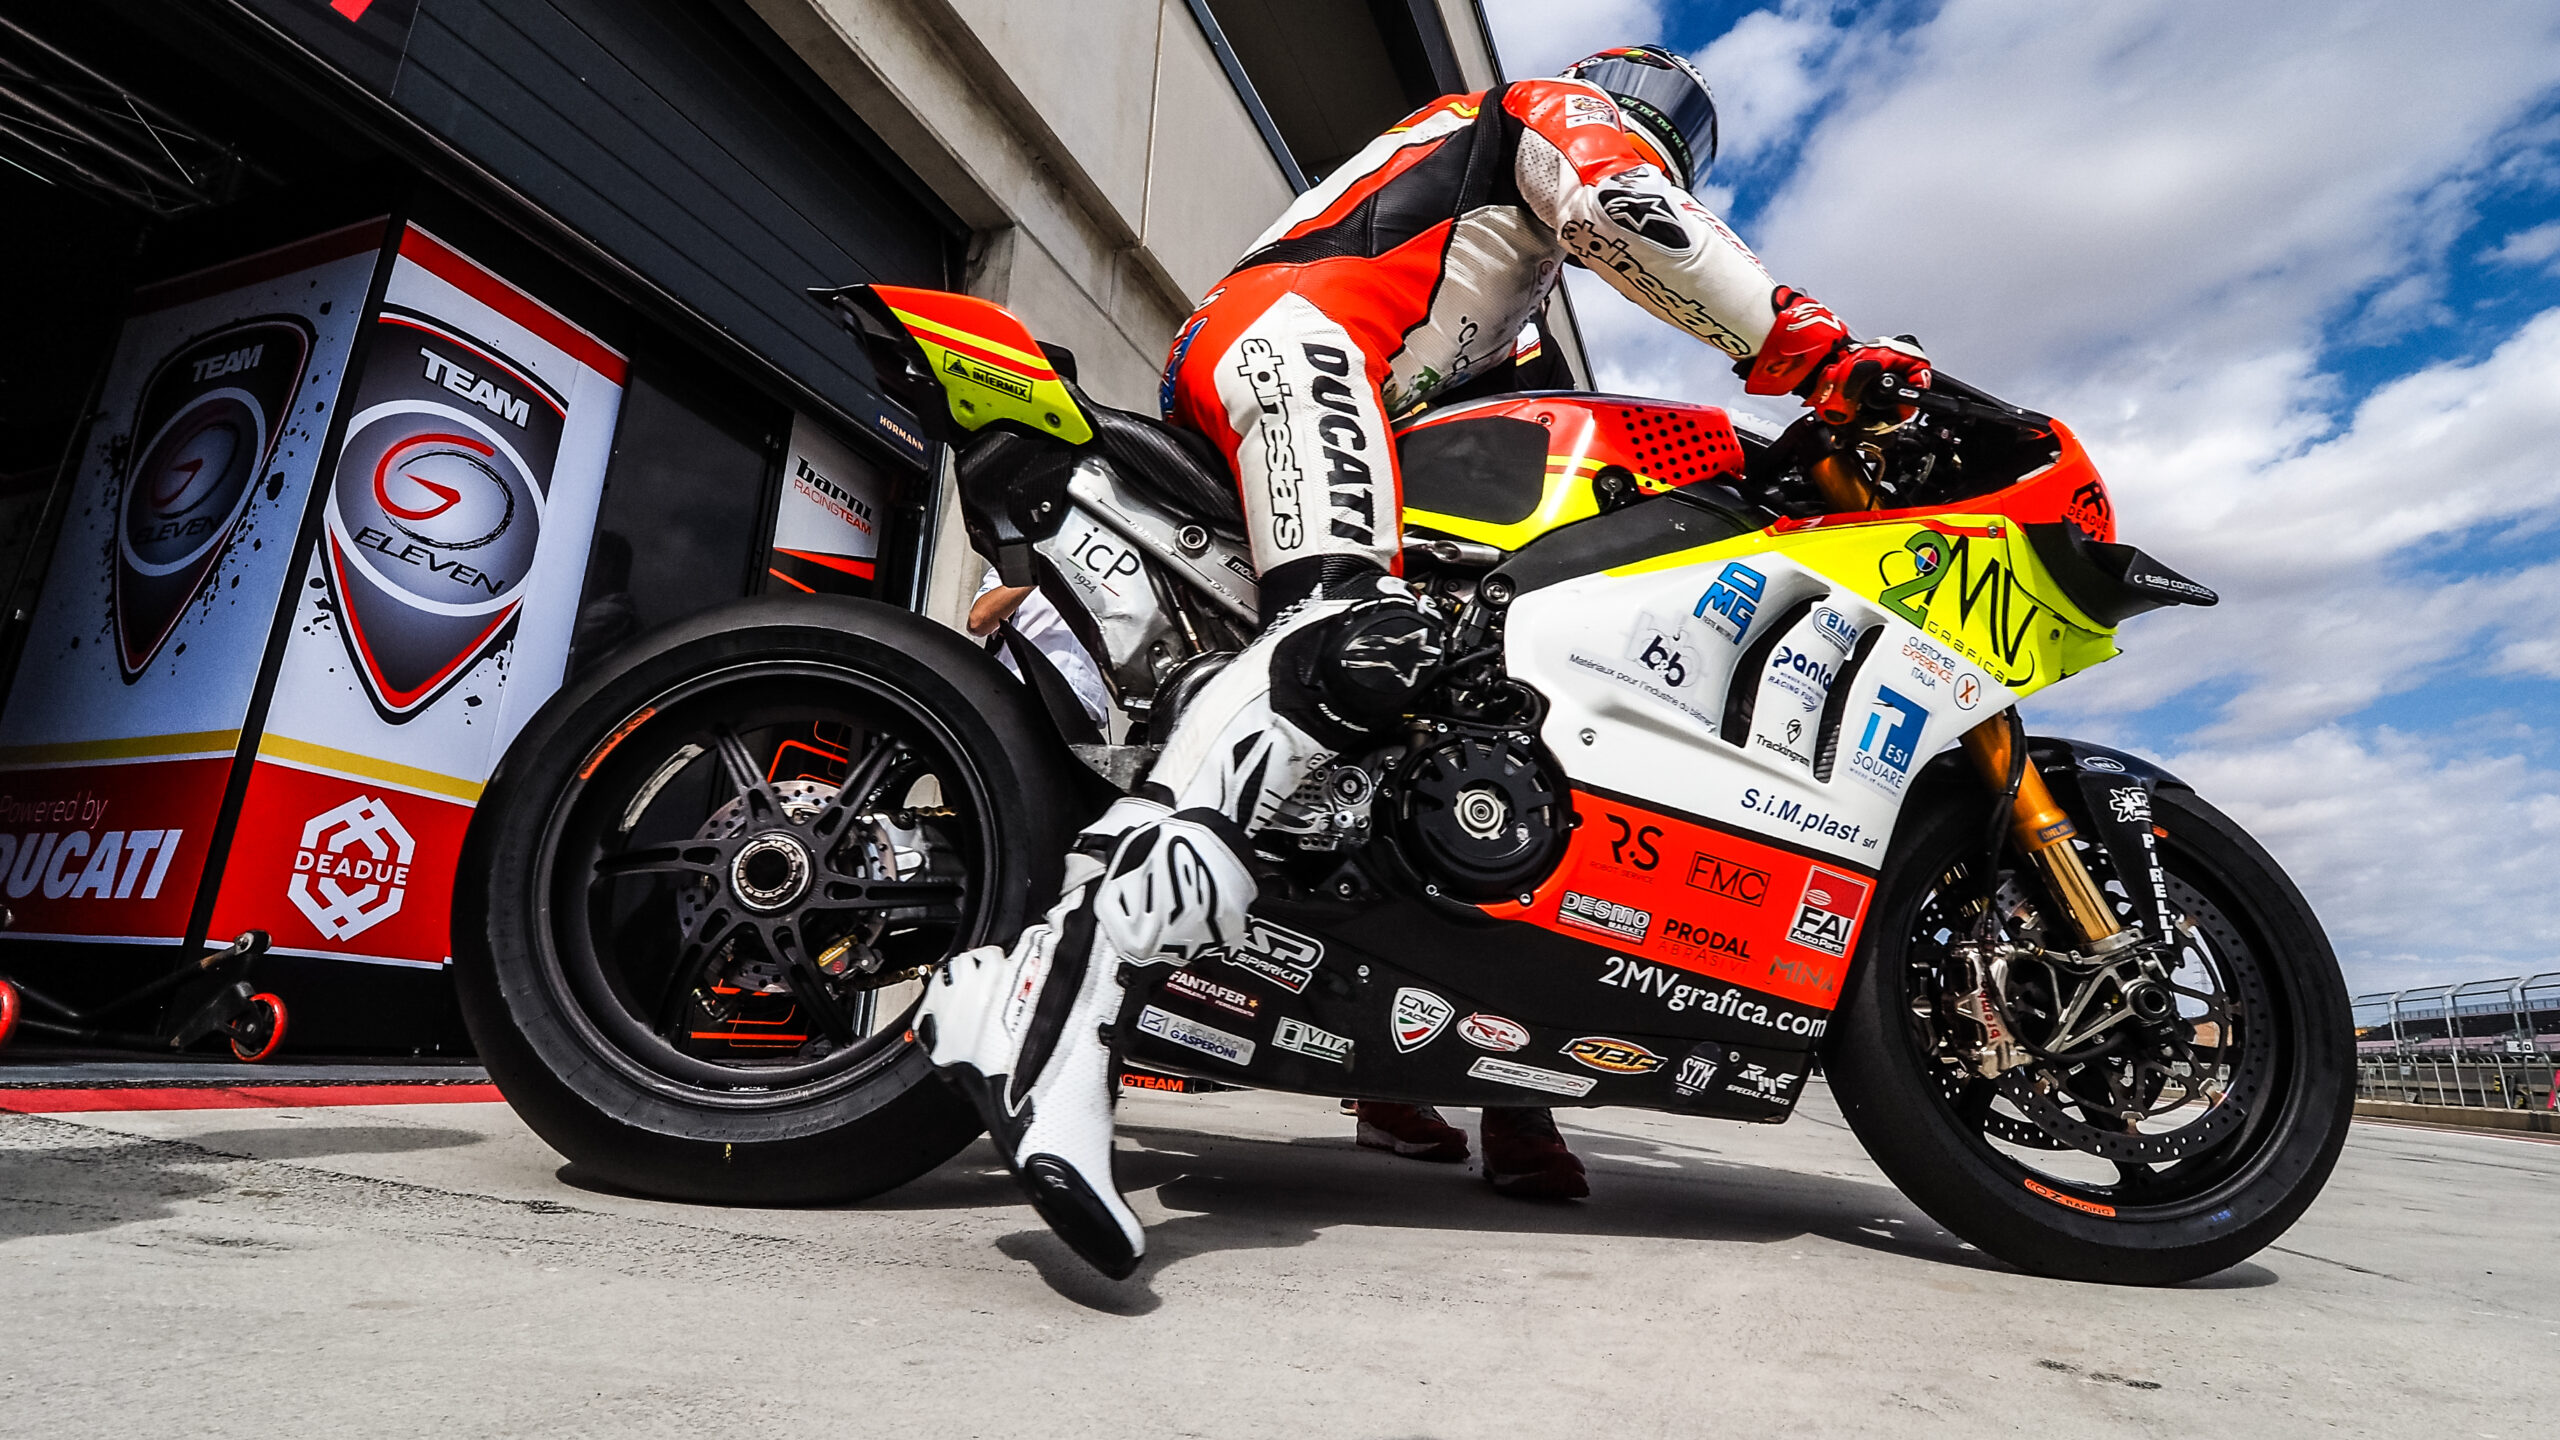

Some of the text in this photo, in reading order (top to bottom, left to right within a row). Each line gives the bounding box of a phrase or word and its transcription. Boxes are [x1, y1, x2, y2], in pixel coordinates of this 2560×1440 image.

[192, 345, 264, 382] TEAM
[419, 346, 530, 429] TEAM
[972, 370, 1028, 399] INTERMIX
[1301, 342, 1375, 546] DUCATI
[796, 455, 873, 523] barni
[132, 514, 224, 546] ELEVEN
[2067, 505, 2109, 533] DEADUE
[353, 526, 507, 596] ELEVEN
[1073, 572, 1098, 594] 1924
[1616, 671, 1637, 687] pour
[1768, 675, 1800, 696] RACING
[1853, 751, 1905, 789] SQUARE
[0, 791, 108, 829] Powered by
[1862, 838, 1879, 849] srl
[293, 850, 410, 886] DEADUE
[1690, 855, 1766, 901] FMC
[2141, 833, 2174, 945] PIRELLI
[1561, 891, 1651, 930] DESMO
[1799, 906, 1853, 943] FAI
[1608, 921, 1646, 937] MARKET
[1663, 919, 1750, 958] PRODAL
[1792, 930, 1818, 945] Auto
[1657, 939, 1748, 976] ABRASIVI
[1168, 970, 1248, 1007] FANTAFER
[1598, 957, 1828, 1039] 2MVgrafica.com
[1397, 1008, 1437, 1028] RACING
[1399, 994, 1448, 1021] CNC
[1170, 1029, 1238, 1060] GASPERONI
[1307, 1026, 1351, 1052] VITA
[1676, 1057, 1718, 1091] STM
